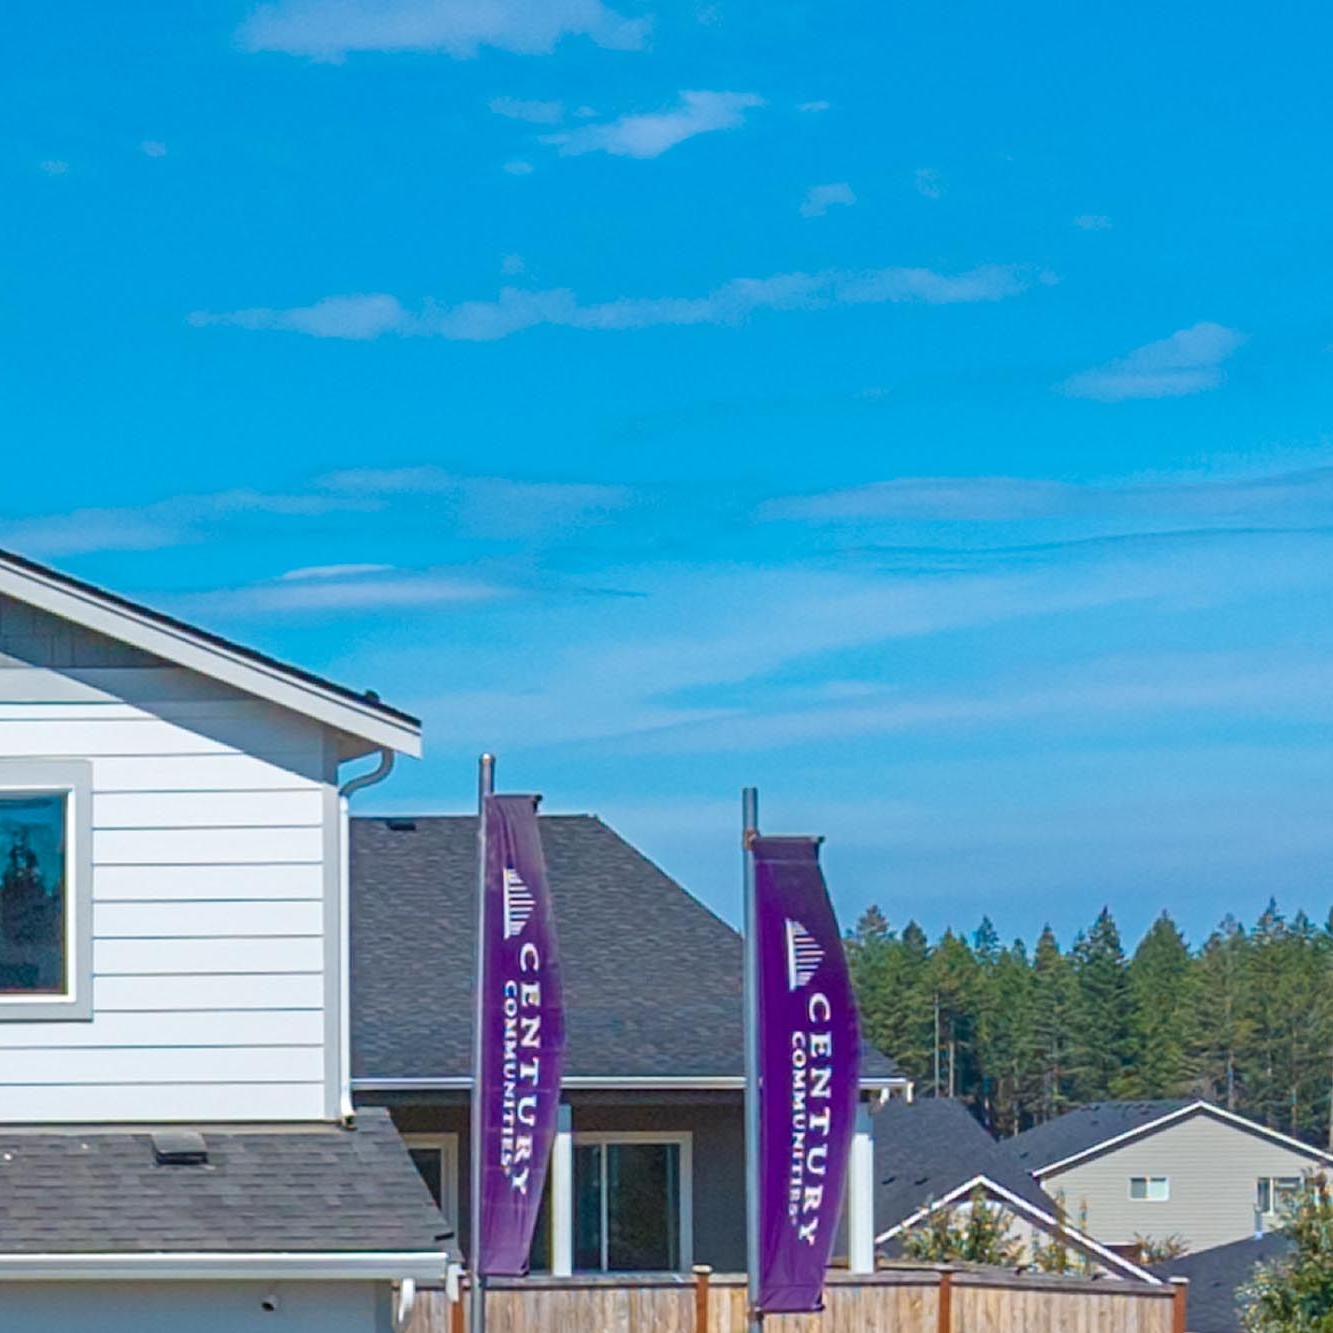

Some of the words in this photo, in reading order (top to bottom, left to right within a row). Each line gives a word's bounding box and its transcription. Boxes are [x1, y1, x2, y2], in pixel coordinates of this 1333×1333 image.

[501, 980, 518, 1171] COMMUNITIES
[511, 942, 541, 1196] CENTURY
[798, 992, 833, 1246] CENTURY
